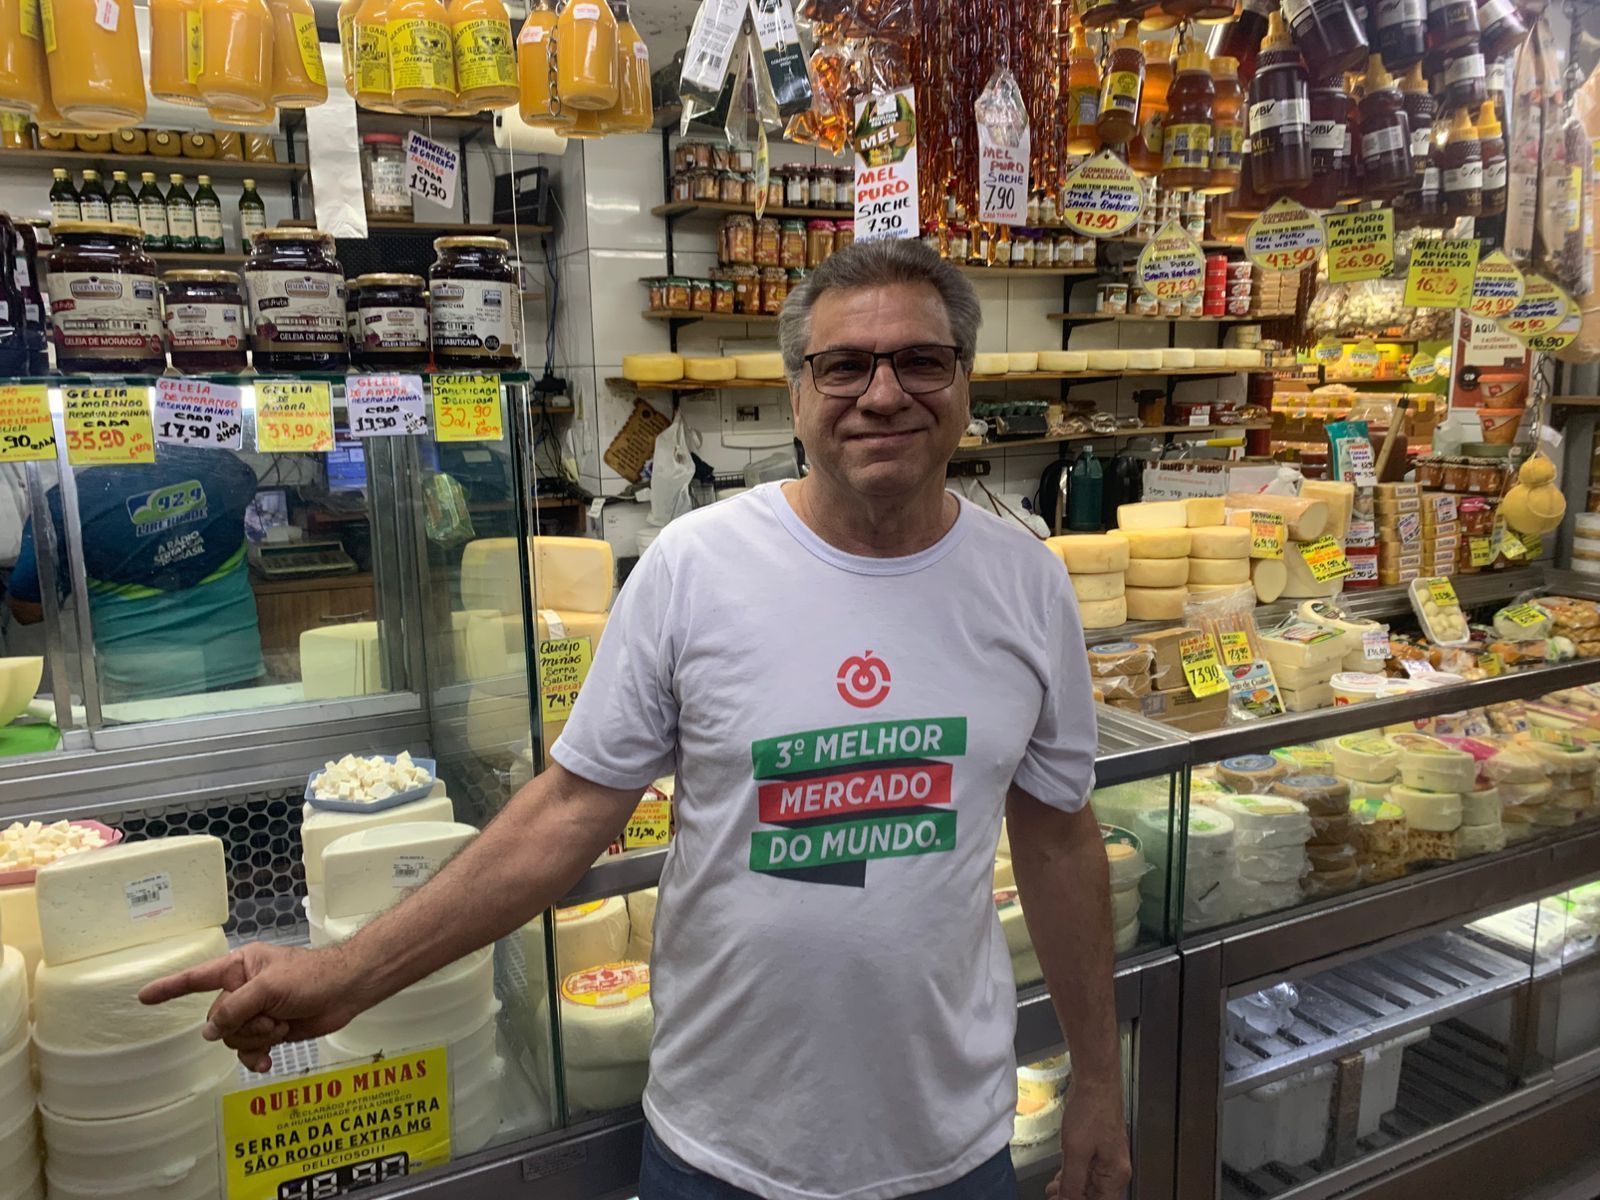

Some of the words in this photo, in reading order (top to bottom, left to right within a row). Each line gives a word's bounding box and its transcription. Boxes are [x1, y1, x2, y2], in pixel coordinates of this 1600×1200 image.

[860, 126, 899, 150] MEL
[983, 146, 1013, 160] MEL
[990, 160, 1024, 173] PURO
[857, 166, 898, 186] MEL
[984, 172, 1024, 185] SACHE
[409, 172, 447, 200] 19,90
[857, 180, 910, 203] PURO
[856, 196, 911, 221] SACHE
[1354, 213, 1384, 224] PURO
[1475, 323, 1496, 333] AQUI
[64, 337, 87, 346] GELEIA
[88, 337, 99, 346] DE
[100, 337, 143, 346] MORANGO
[280, 333, 304, 341] GELEIA
[306, 333, 316, 341] DE
[444, 337, 480, 346] JABUTICABA
[67, 389, 128, 399] GELEIA
[181, 395, 238, 409] MORANGO
[81, 399, 143, 408] MORANGO
[204, 407, 235, 417] MINAS
[83, 419, 130, 428] CADA
[540, 640, 580, 656] Queijo
[814, 724, 943, 763] MELHOR
[779, 771, 932, 815] MERCADO
[769, 835, 812, 865] DO
[821, 820, 941, 860] MUNDO.
[250, 1078, 343, 1117] QUEIJO
[353, 1059, 428, 1094] MINAS
[289, 1100, 345, 1120] DECLARADO
[346, 1088, 400, 1107] PATRIMÔNIO
[291, 1106, 350, 1128] HUMANIDADE
[351, 1102, 376, 1115] PELA
[376, 1093, 412, 1109] UNESCO
[235, 1130, 301, 1159] SERRA
[307, 1121, 333, 1141] DA
[340, 1096, 440, 1132] CANASTRA
[244, 1152, 280, 1175] SÃO
[286, 1135, 344, 1163] ROQUE
[350, 1122, 401, 1148] EXTRA
[407, 1116, 432, 1133] MG
